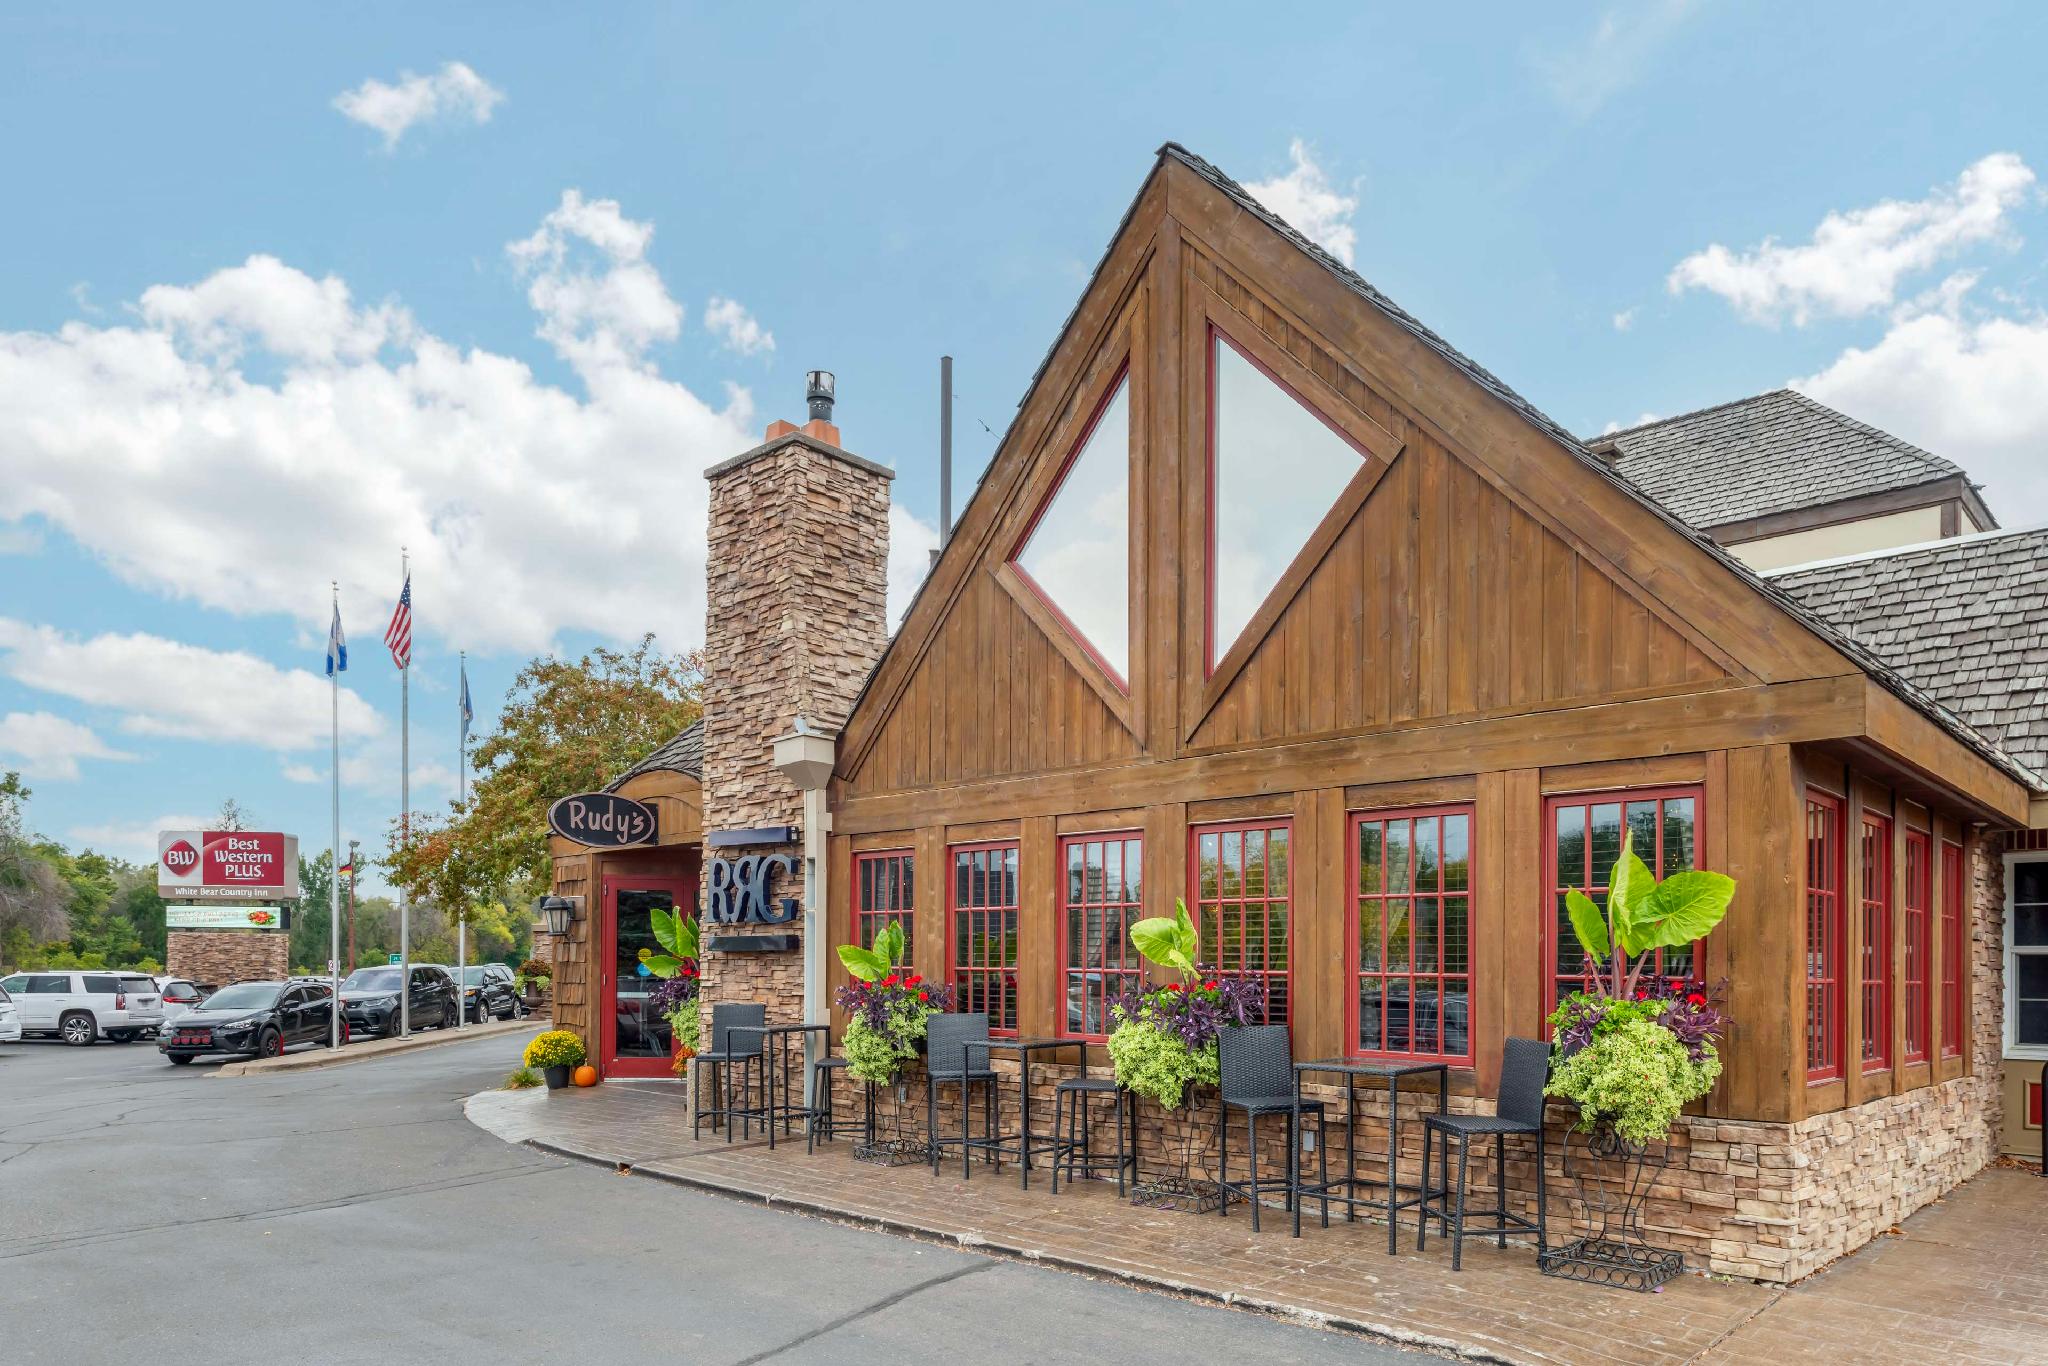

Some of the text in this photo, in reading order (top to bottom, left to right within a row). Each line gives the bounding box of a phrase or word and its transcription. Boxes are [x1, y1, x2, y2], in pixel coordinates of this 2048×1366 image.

[568, 800, 645, 844] Rudy's
[228, 838, 260, 850] Best
[167, 851, 195, 865] BW
[214, 850, 273, 863] Western
[175, 887, 268, 898] White Bear Country Inn
